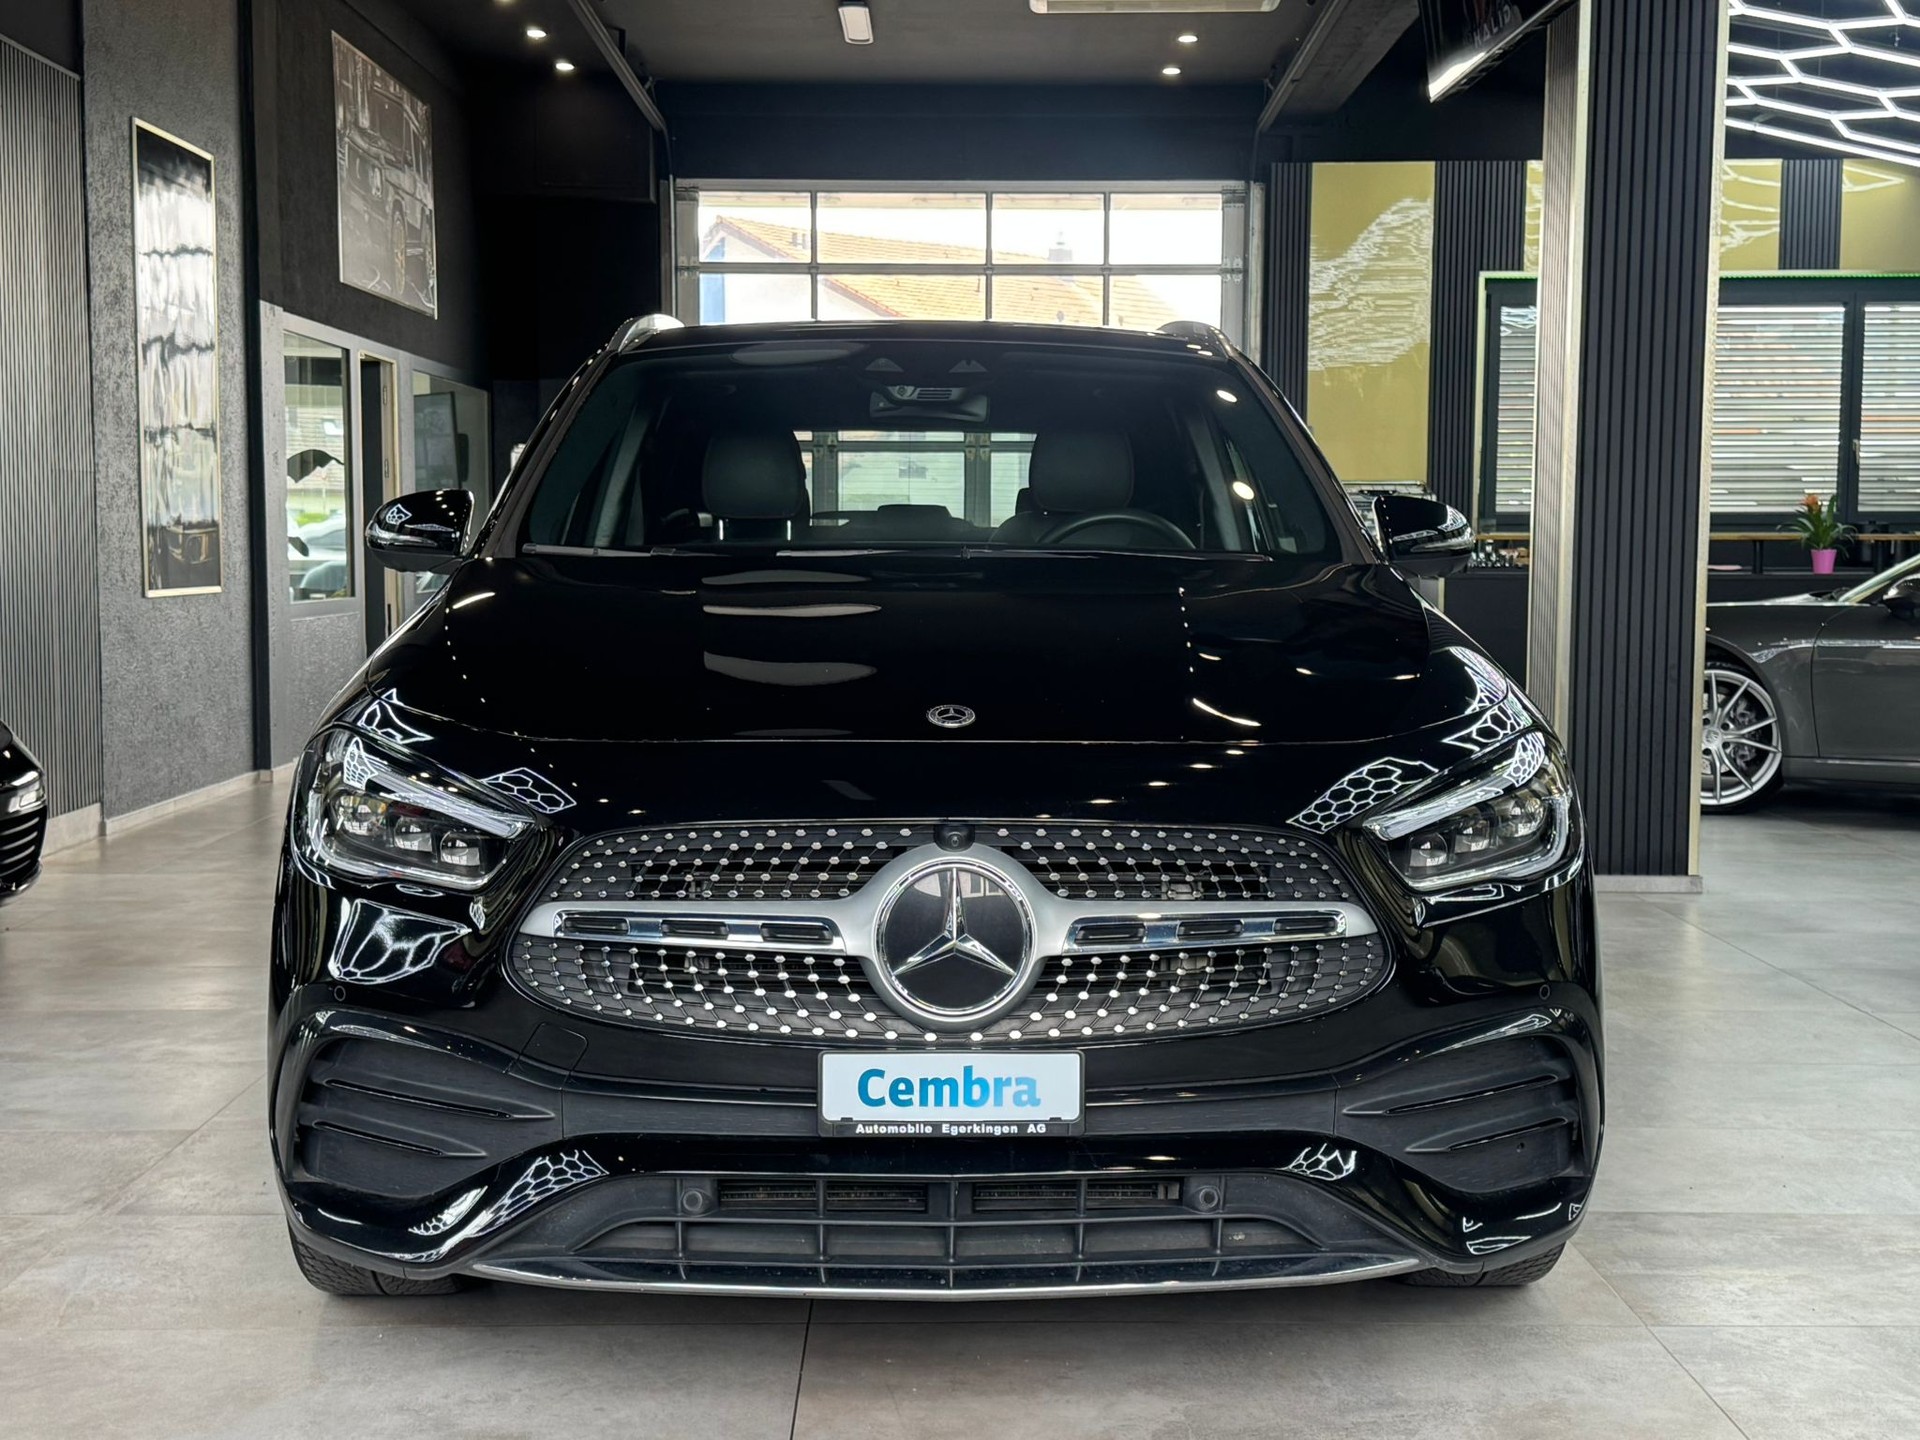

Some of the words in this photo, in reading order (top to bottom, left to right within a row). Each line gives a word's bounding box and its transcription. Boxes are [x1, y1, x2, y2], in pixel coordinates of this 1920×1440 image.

[858, 1065, 1041, 1107] Cembra
[855, 1123, 933, 1134] Automobile
[941, 1123, 1018, 1136] Egerkingen
[1027, 1123, 1047, 1134] AG
